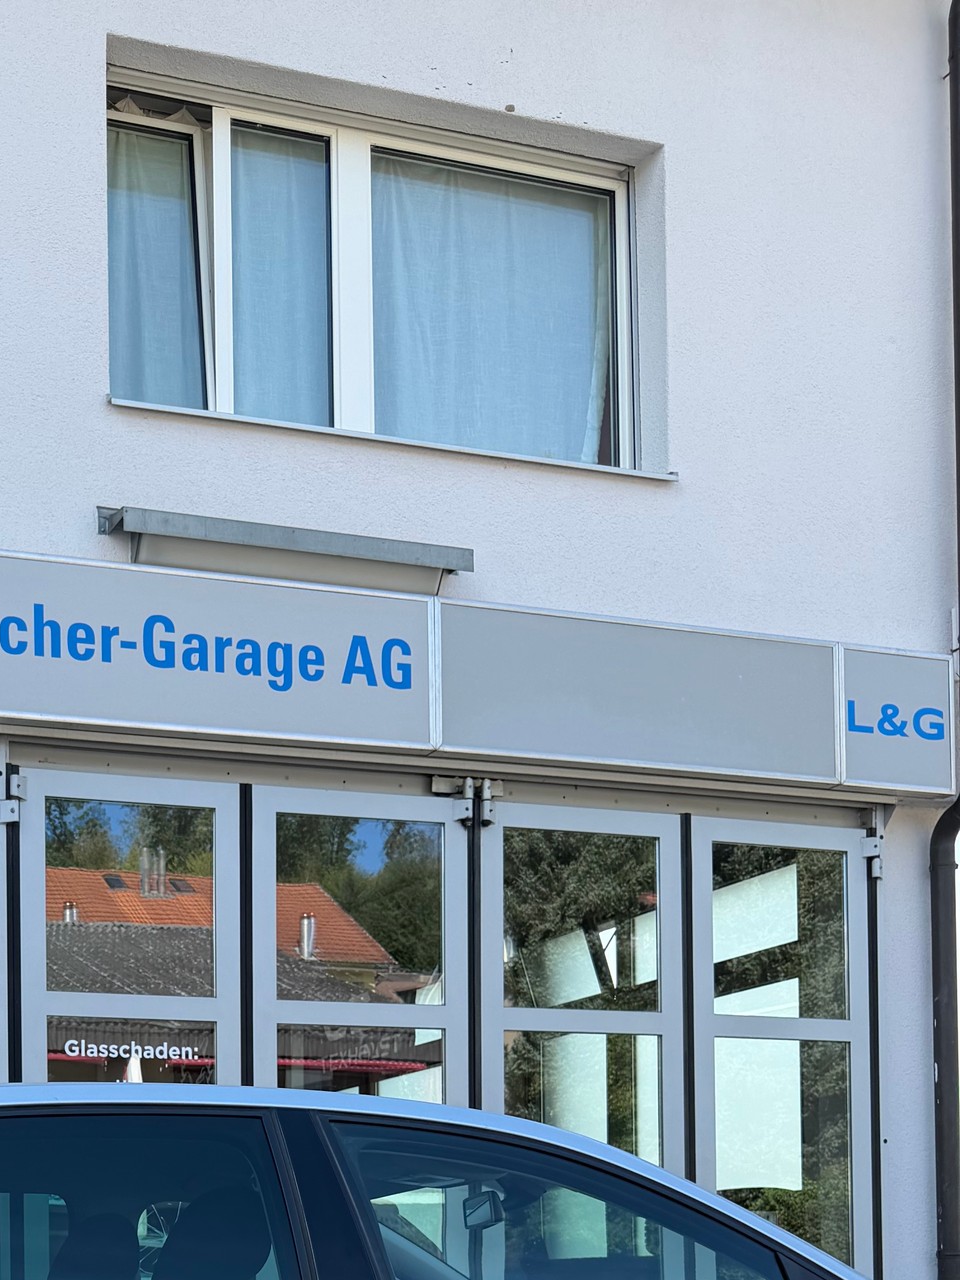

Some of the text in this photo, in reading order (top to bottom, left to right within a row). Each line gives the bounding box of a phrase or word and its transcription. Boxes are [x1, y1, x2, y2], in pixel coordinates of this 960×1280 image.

[341, 635, 412, 691] AG
[847, 699, 945, 741] L&G
[64, 1039, 199, 1060] Glasschaden:
